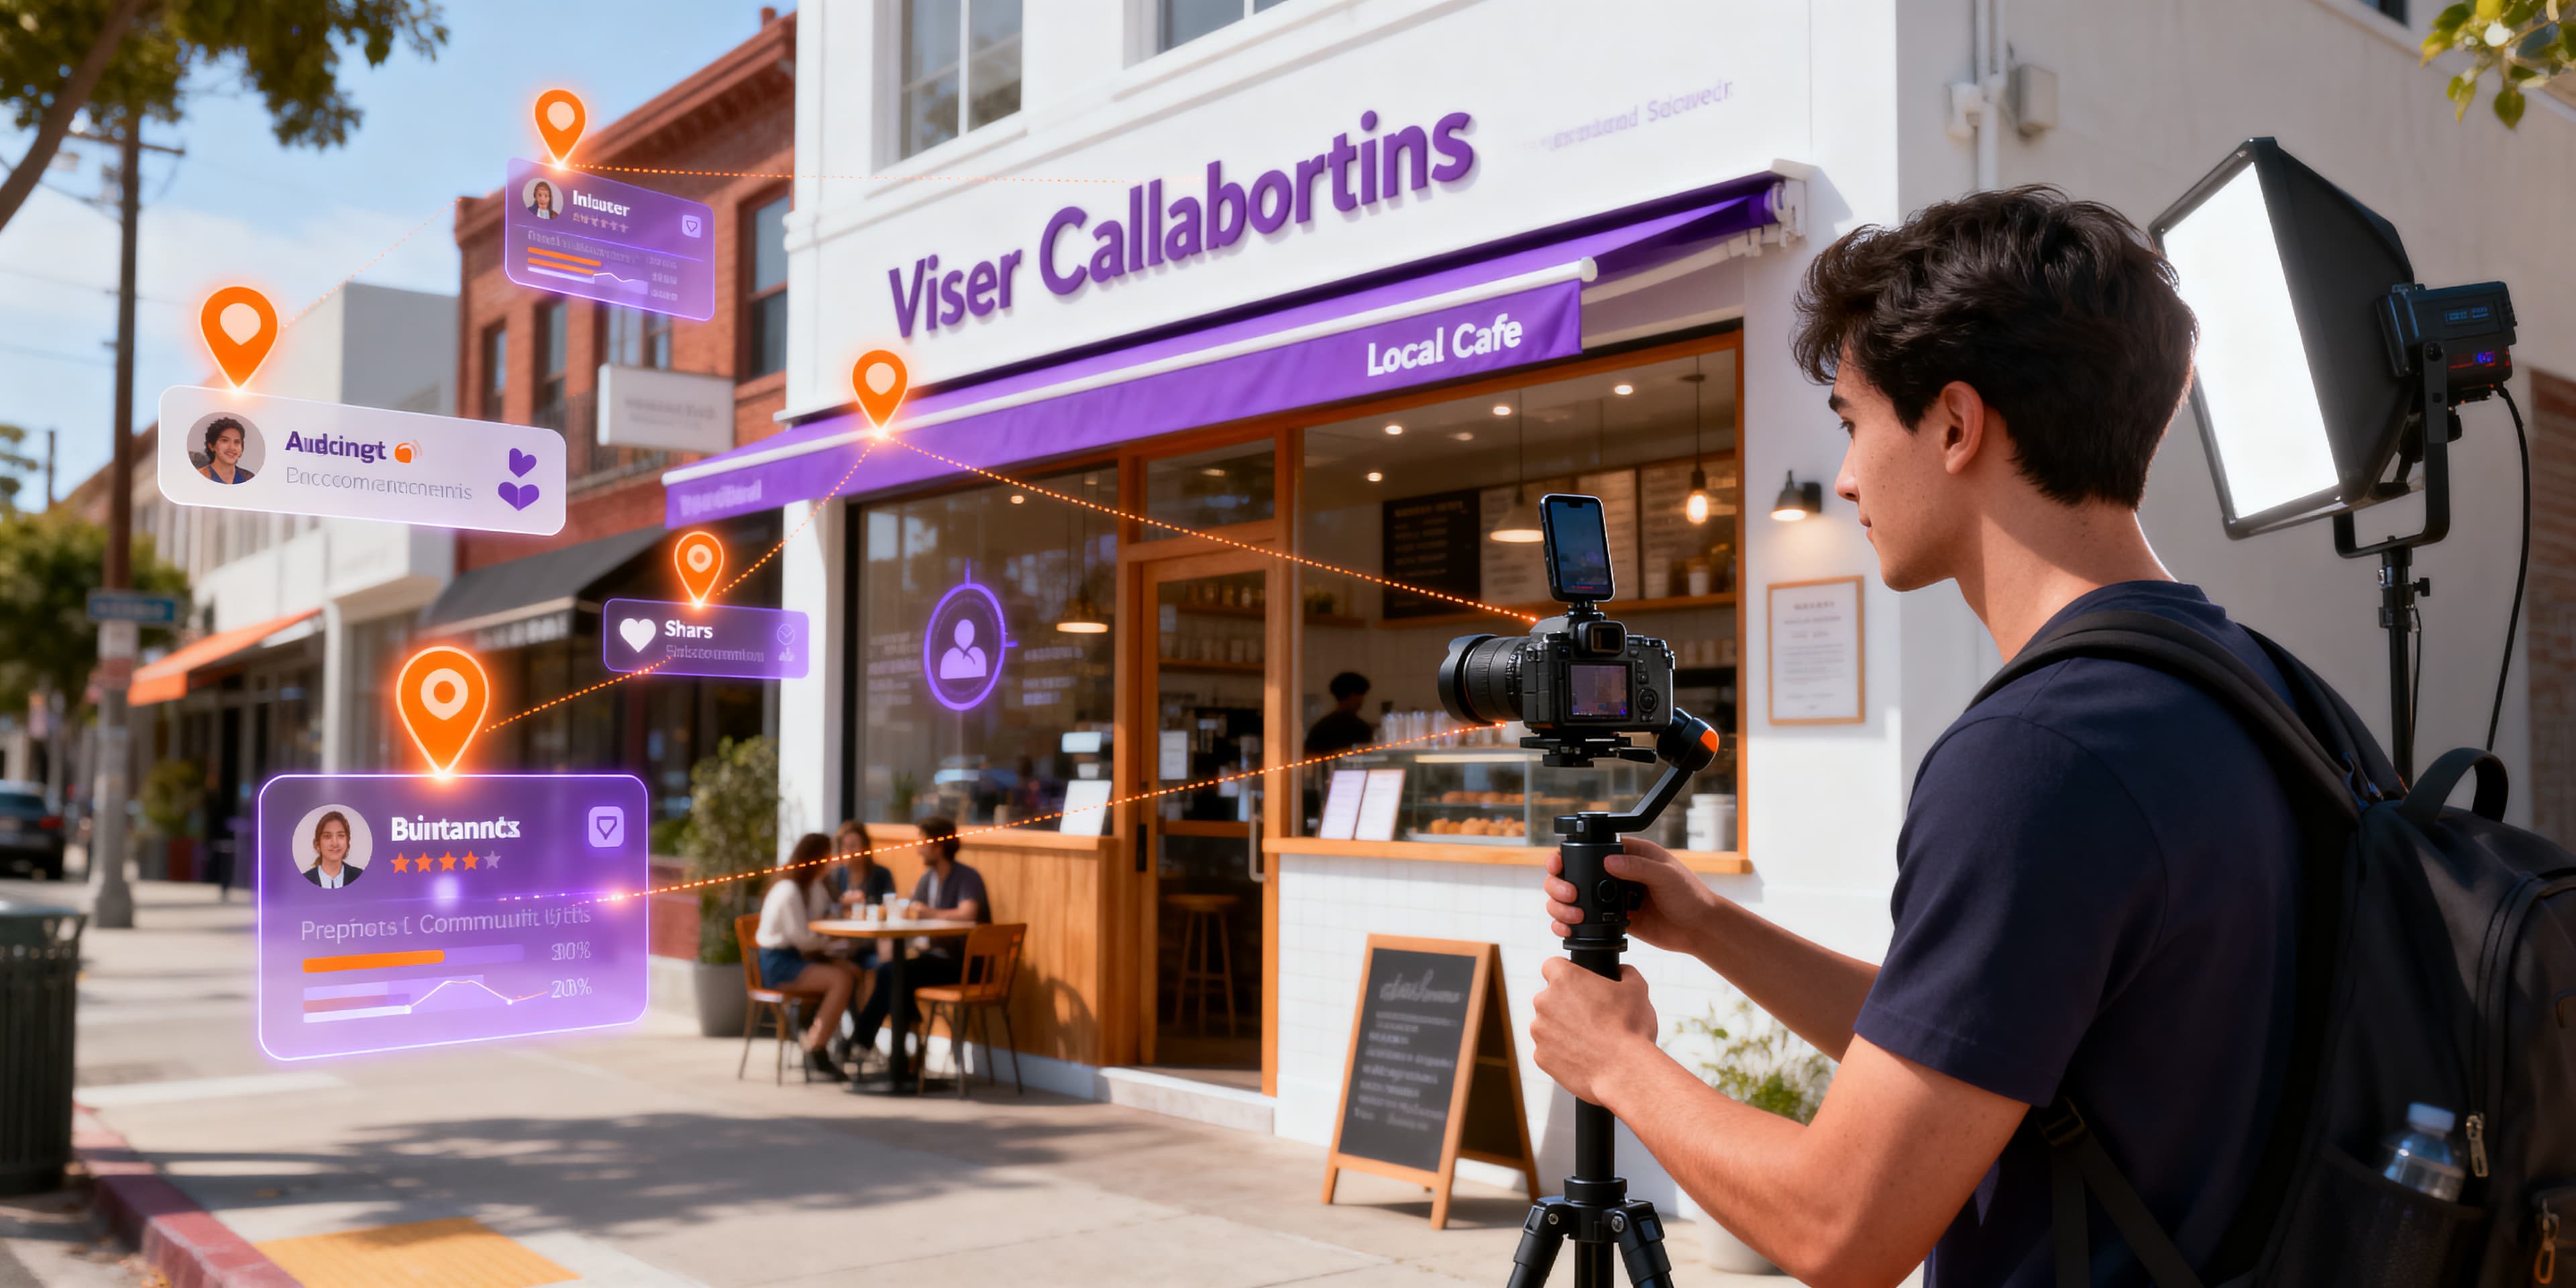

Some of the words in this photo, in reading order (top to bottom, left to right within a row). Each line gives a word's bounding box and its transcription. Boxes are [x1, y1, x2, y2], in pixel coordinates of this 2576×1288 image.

[888, 248, 1022, 339] Viser
[1038, 109, 1475, 297] Callabortins
[1367, 327, 1444, 377] Local
[1452, 313, 1523, 359] Cafe
